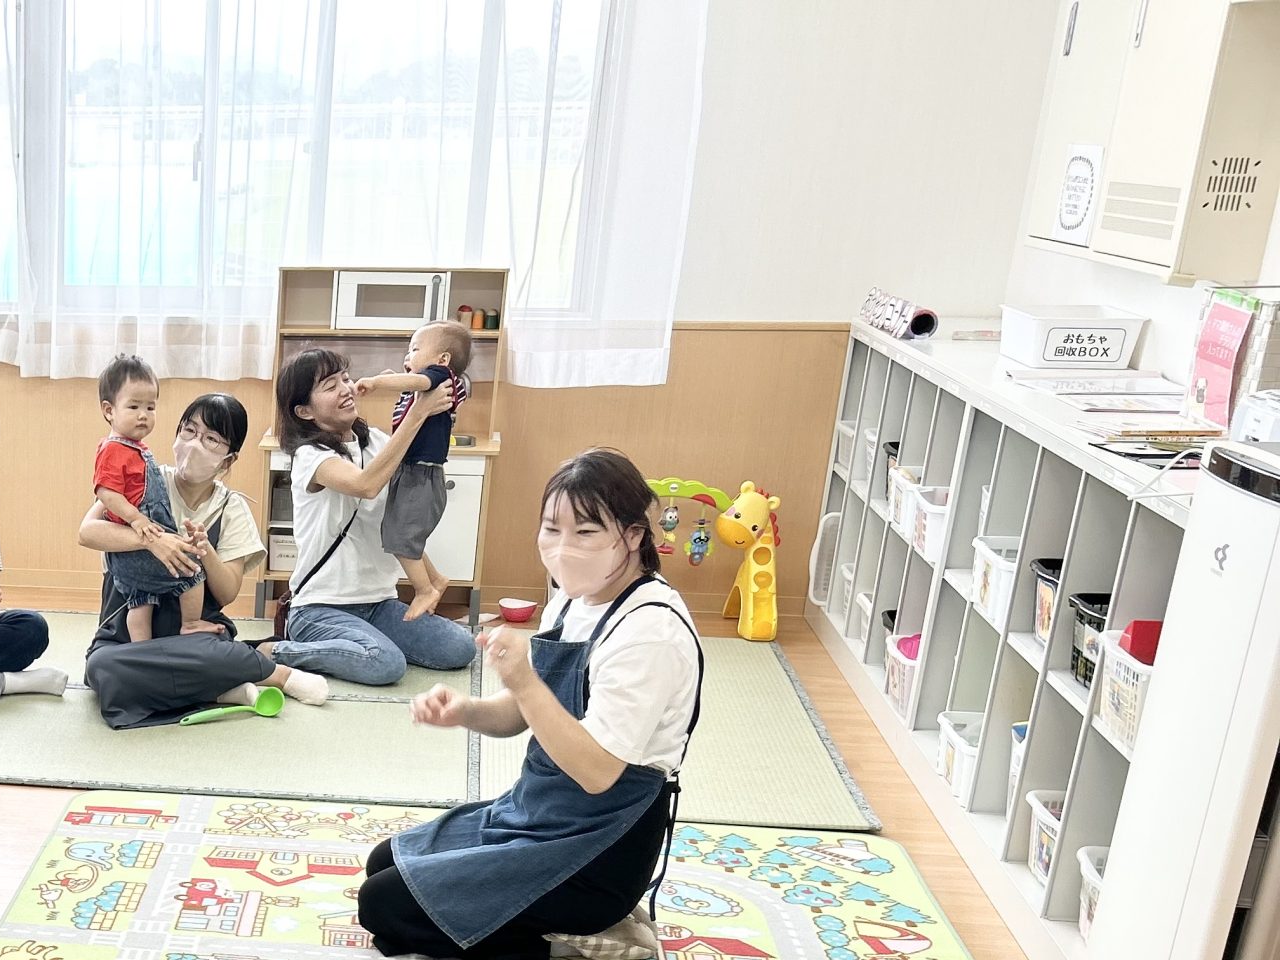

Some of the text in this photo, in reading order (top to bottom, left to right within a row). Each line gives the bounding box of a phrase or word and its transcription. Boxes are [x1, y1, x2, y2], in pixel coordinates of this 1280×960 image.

[1063, 333, 1108, 345] おもちゃ
[1054, 346, 1111, 358] 回収BOX
